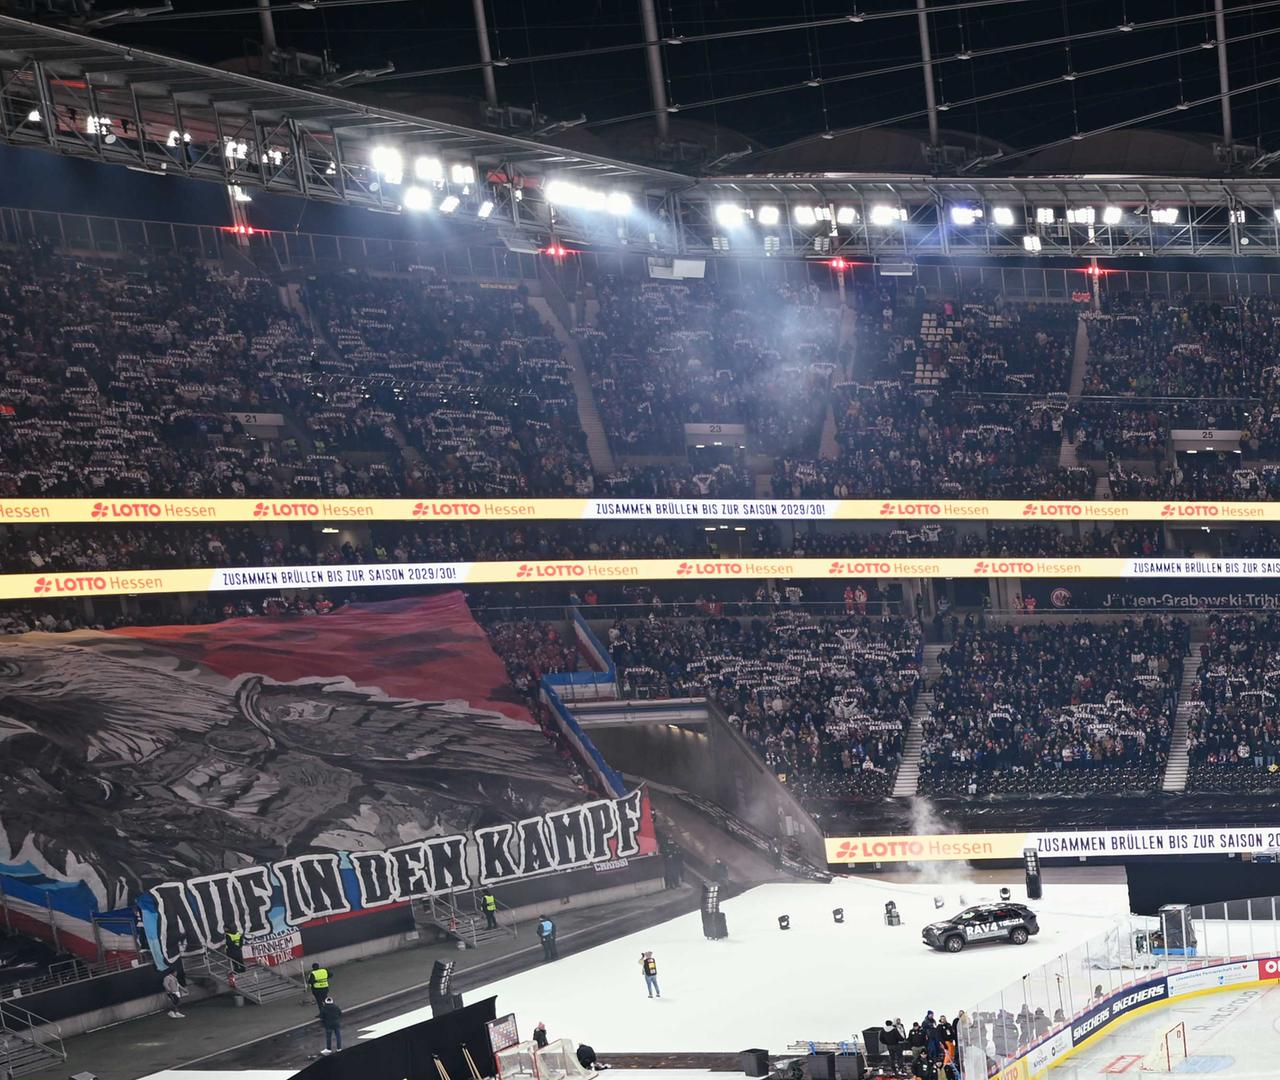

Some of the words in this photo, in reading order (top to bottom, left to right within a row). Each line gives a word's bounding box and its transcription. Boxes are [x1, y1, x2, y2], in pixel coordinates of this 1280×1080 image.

[245, 415, 257, 423] 21
[112, 504, 161, 517] LOTTO
[165, 504, 215, 516] Hessen
[596, 504, 651, 514] ZUSAMMEN
[656, 503, 698, 514] BRÜLLEN
[702, 504, 718, 514] BIS
[722, 504, 739, 514] ZUR
[743, 504, 777, 515] SAISON
[781, 504, 824, 515] 2029/30!
[992, 563, 1034, 573] LOTTO
[1038, 564, 1080, 572] Hessen
[55, 577, 106, 591] LOTTO
[110, 577, 162, 589] Hessen
[223, 572, 277, 585] ZUSAMMEN
[281, 570, 323, 583] BRÜLLEN
[327, 570, 343, 582] BIS
[347, 570, 364, 581] ZUR
[369, 569, 404, 581] SAISON
[408, 568, 456, 579] 2029/30!
[1037, 838, 1105, 853] ZUSAMMEN
[1111, 835, 1163, 850] BRÜLLEN
[1169, 835, 1187, 848] BIS
[1194, 835, 1215, 848] ZUR
[1220, 834, 1262, 847] SAISON
[150, 866, 272, 963] AUF
[273, 854, 351, 926] IN
[348, 834, 471, 905] DEN
[474, 789, 643, 886] KAMPF
[966, 922, 998, 937] RAV4
[1113, 984, 1165, 1015] SKECHERS
[1073, 1008, 1110, 1041] SKECHERS
